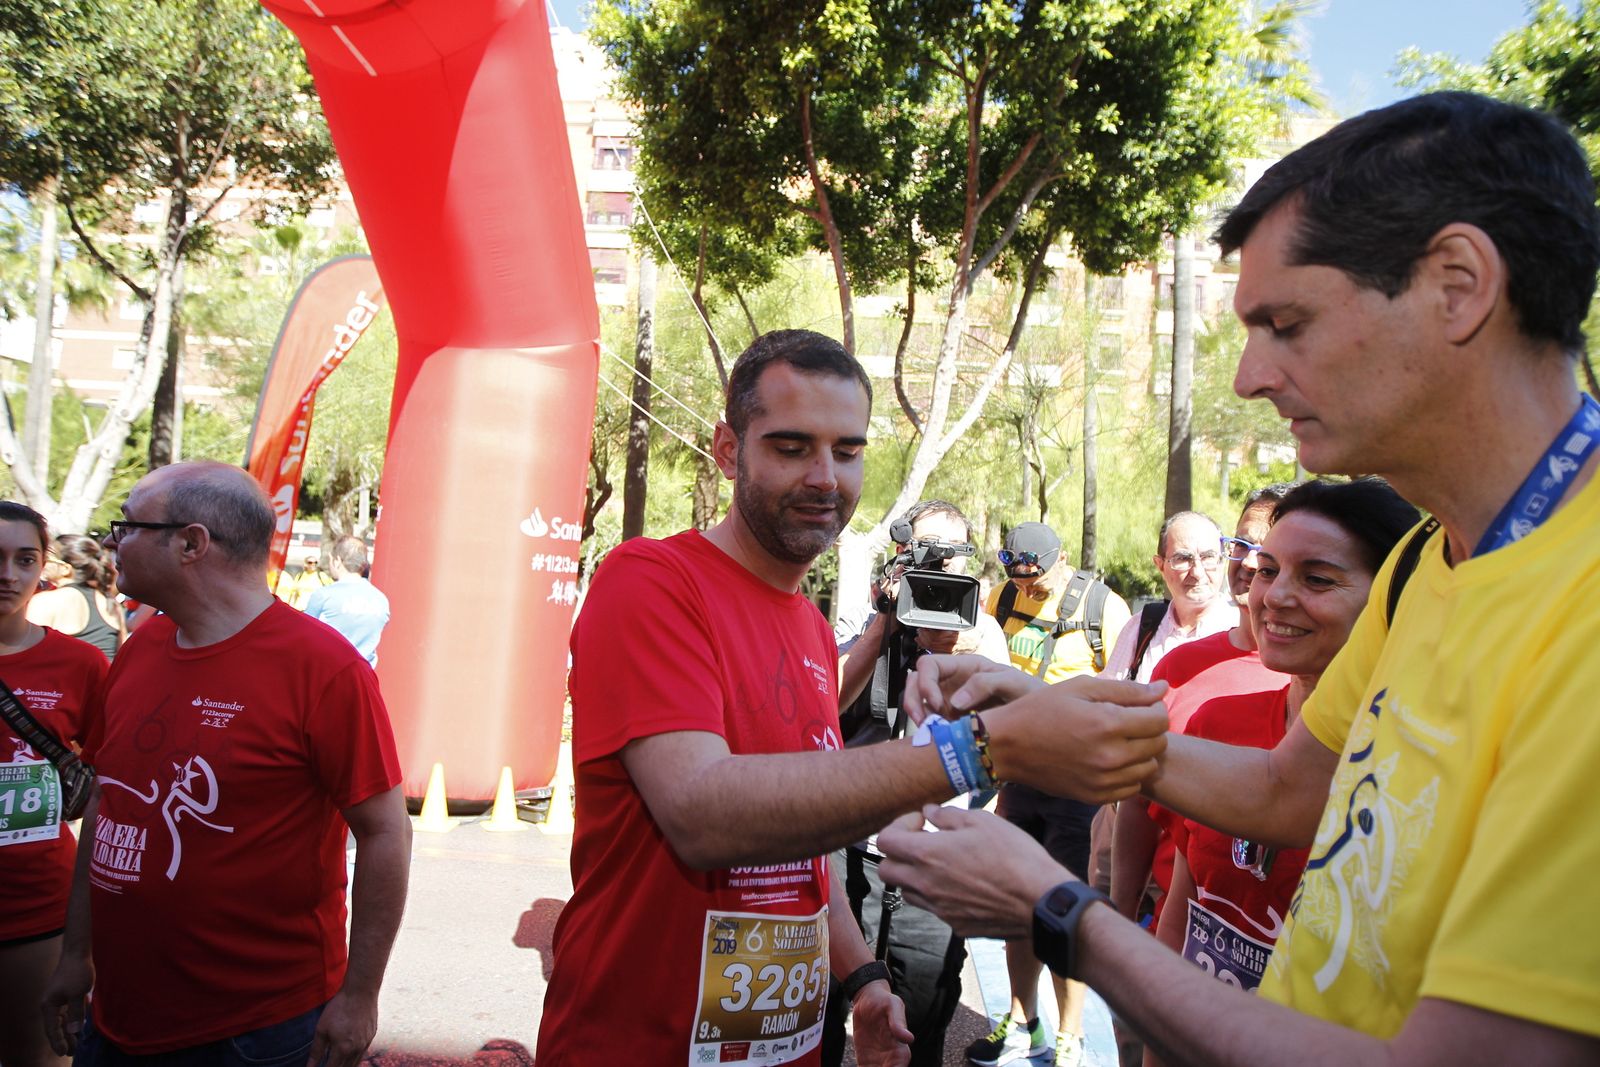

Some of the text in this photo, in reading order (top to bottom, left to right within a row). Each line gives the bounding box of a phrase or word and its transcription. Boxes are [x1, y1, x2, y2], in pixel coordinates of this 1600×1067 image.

[203, 698, 245, 711] Santander
[712, 938, 737, 955] 2019
[746, 921, 763, 953] 6
[1214, 927, 1226, 953] 6
[719, 956, 823, 1013] 3285
[760, 1009, 800, 1035] RAMÓN
